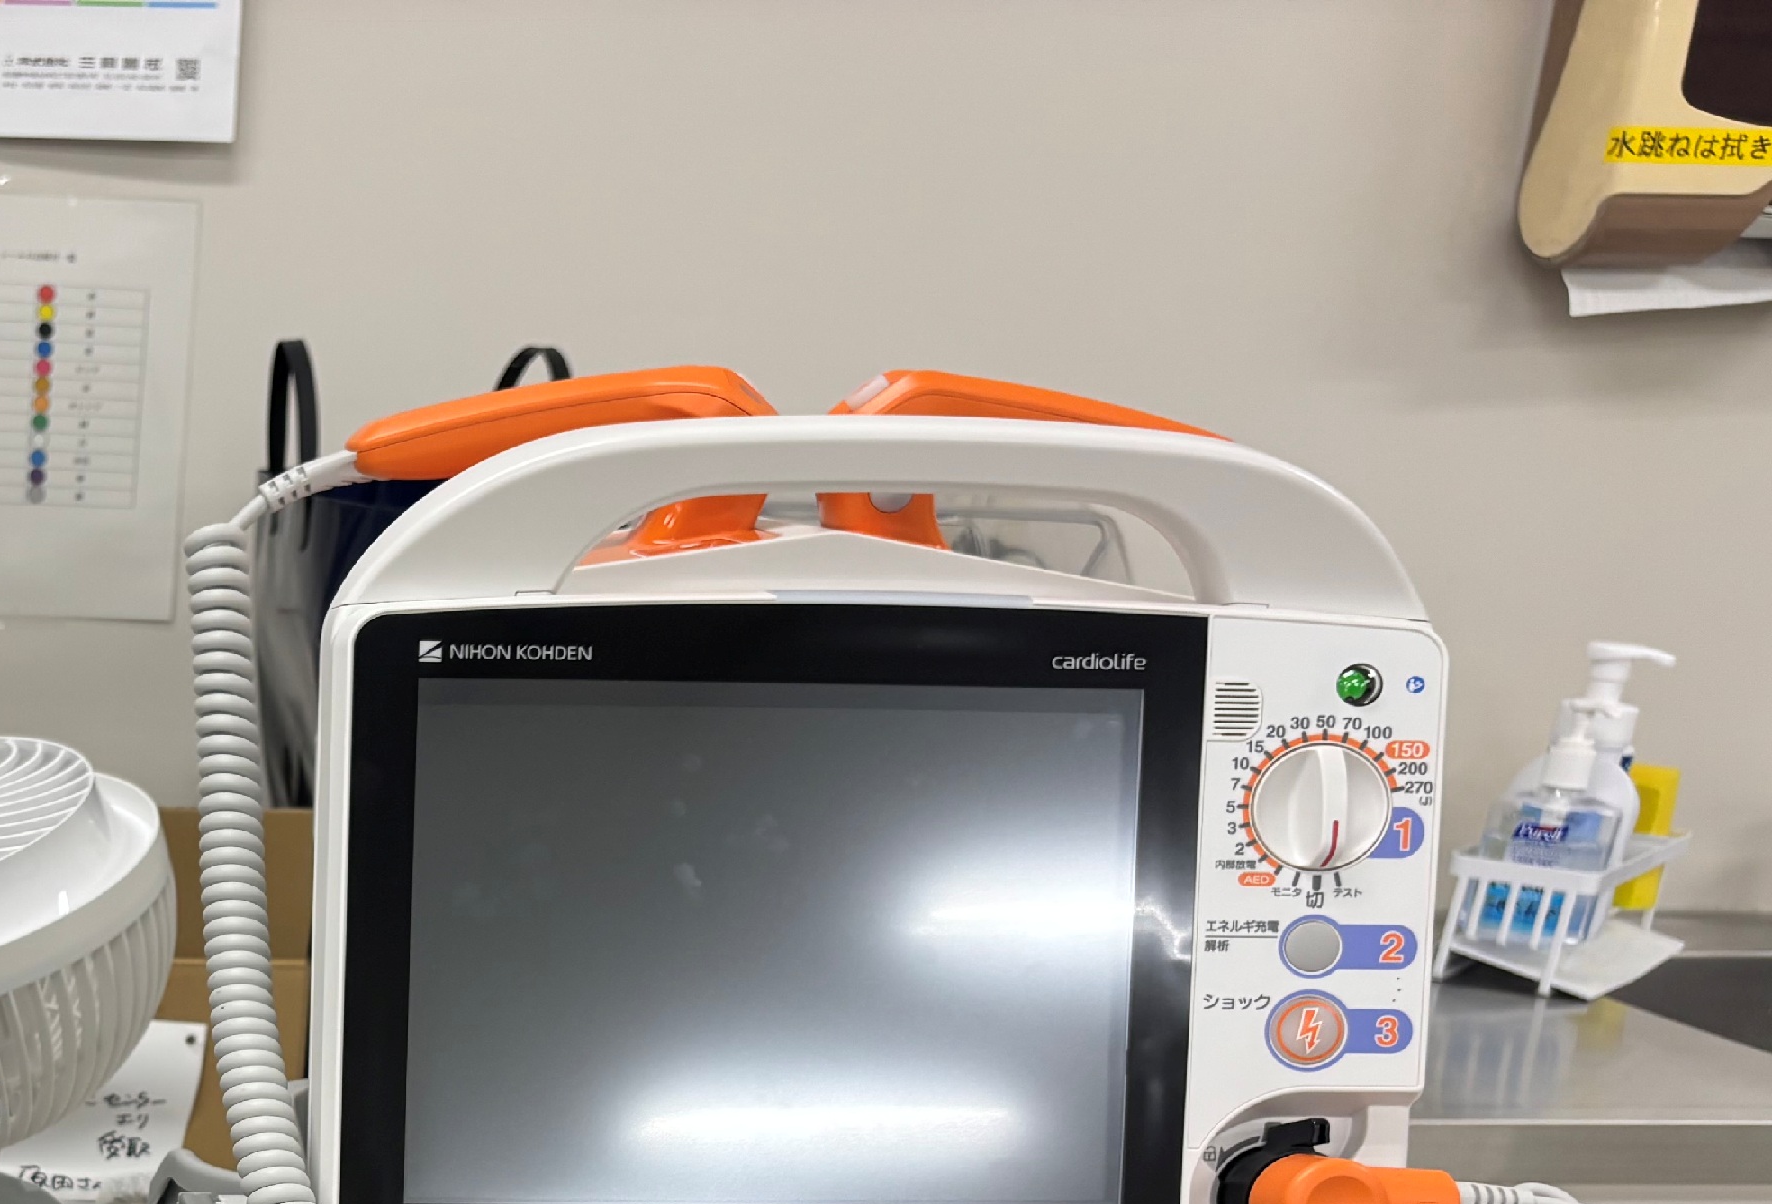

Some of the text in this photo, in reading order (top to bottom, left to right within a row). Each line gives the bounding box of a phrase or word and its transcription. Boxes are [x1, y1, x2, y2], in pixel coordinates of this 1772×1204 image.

[1607, 130, 1772, 161] 水跳ねは拭き
[449, 643, 593, 661] NIHON KOHDEN
[1052, 653, 1147, 670] cardiolife
[1290, 717, 1310, 729] 30
[1316, 715, 1336, 728] 50
[1342, 717, 1363, 730] 70
[1266, 725, 1286, 738] 20
[1363, 727, 1393, 738] 100
[1246, 741, 1264, 753] 15
[1392, 743, 1425, 758] 150
[1232, 757, 1250, 770] 10
[1397, 762, 1428, 775] 200
[1230, 778, 1241, 790] 7
[1405, 781, 1433, 794] 270
[1226, 801, 1236, 813] 5
[1227, 822, 1237, 834] 3
[1393, 817, 1412, 851] 1
[1234, 842, 1245, 856] 2
[1243, 874, 1271, 885] AED
[1270, 887, 1303, 897] モニタ
[1333, 888, 1363, 897] テスト
[1305, 891, 1324, 909] 切
[1206, 919, 1280, 933] エネルギ充電
[1204, 940, 1230, 952] 解析
[1379, 930, 1405, 963] 2
[1203, 994, 1271, 1010] ショック
[1374, 1015, 1399, 1048] 3
